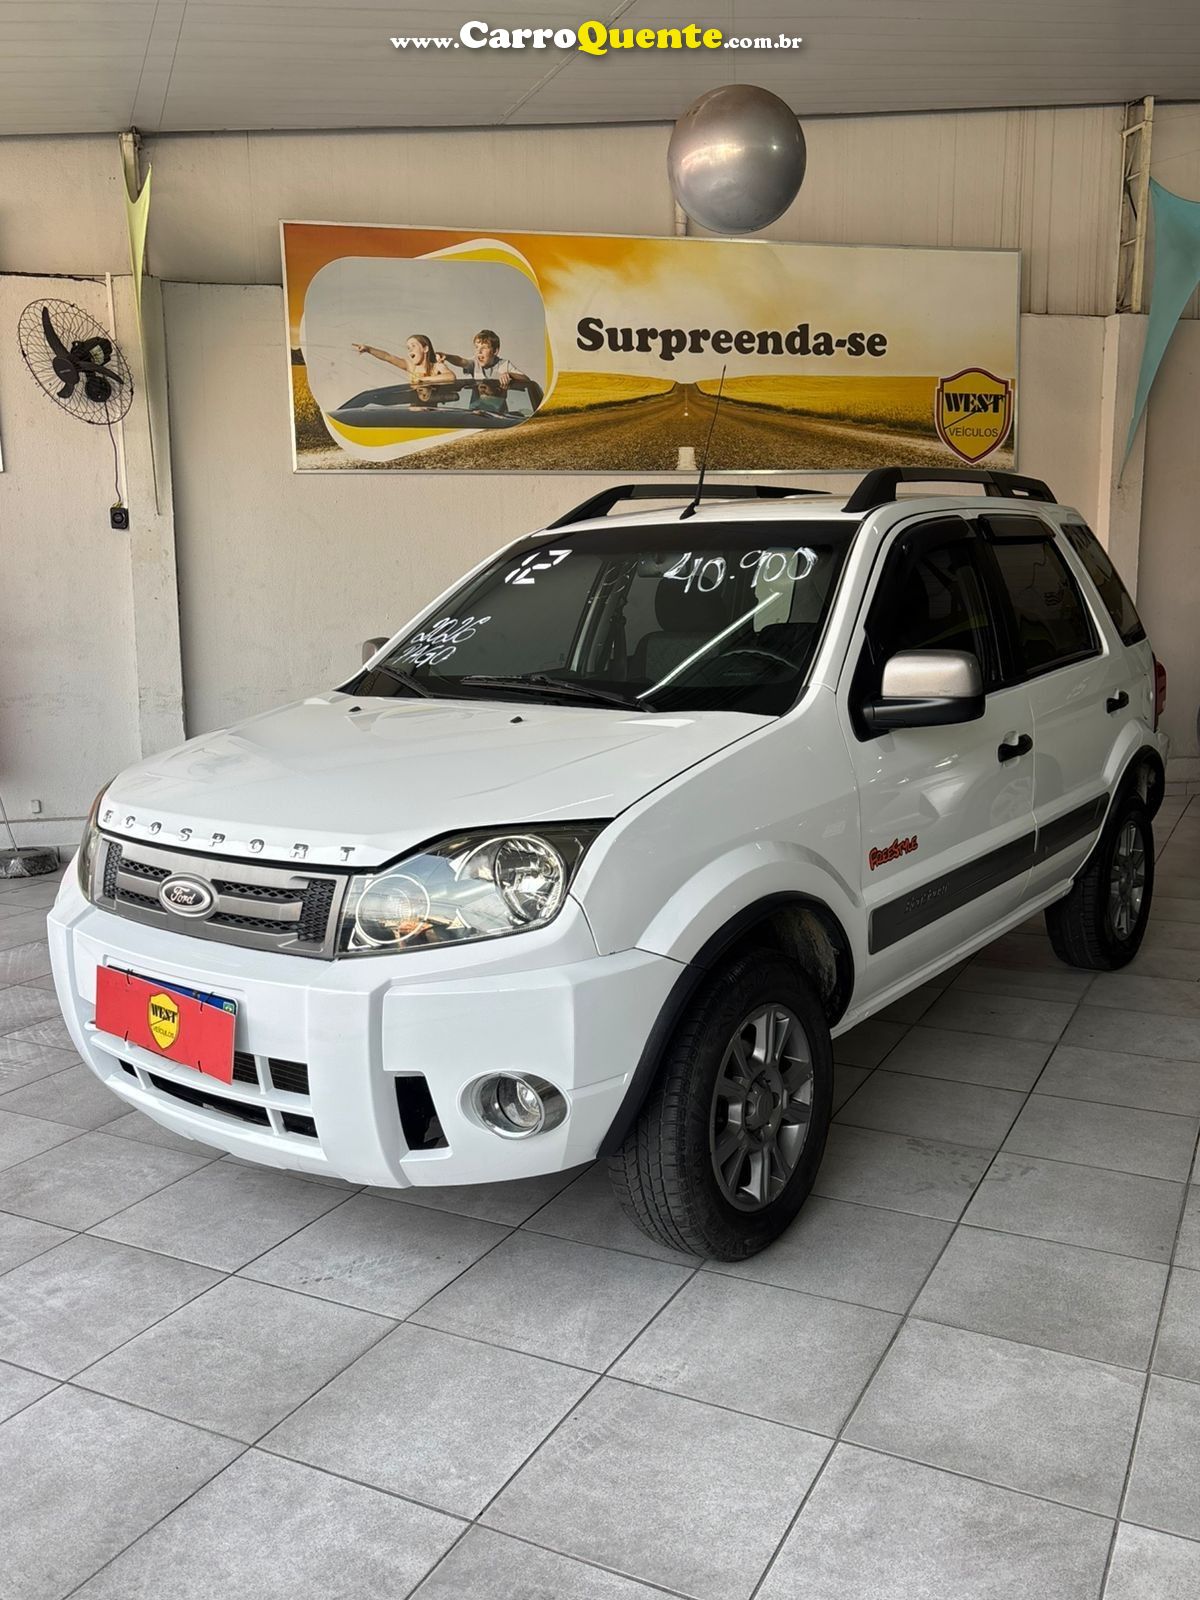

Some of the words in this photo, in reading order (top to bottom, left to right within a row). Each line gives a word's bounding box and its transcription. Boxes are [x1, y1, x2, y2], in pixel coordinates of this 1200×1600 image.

[577, 317, 888, 361] Surpreenda-se
[944, 392, 1006, 414] WEST
[948, 425, 999, 439] VEÍCULOS
[662, 547, 818, 593] 40.900
[102, 809, 356, 862] ECOSPORT
[169, 886, 196, 905] Ford
[150, 1003, 179, 1025] WEST
